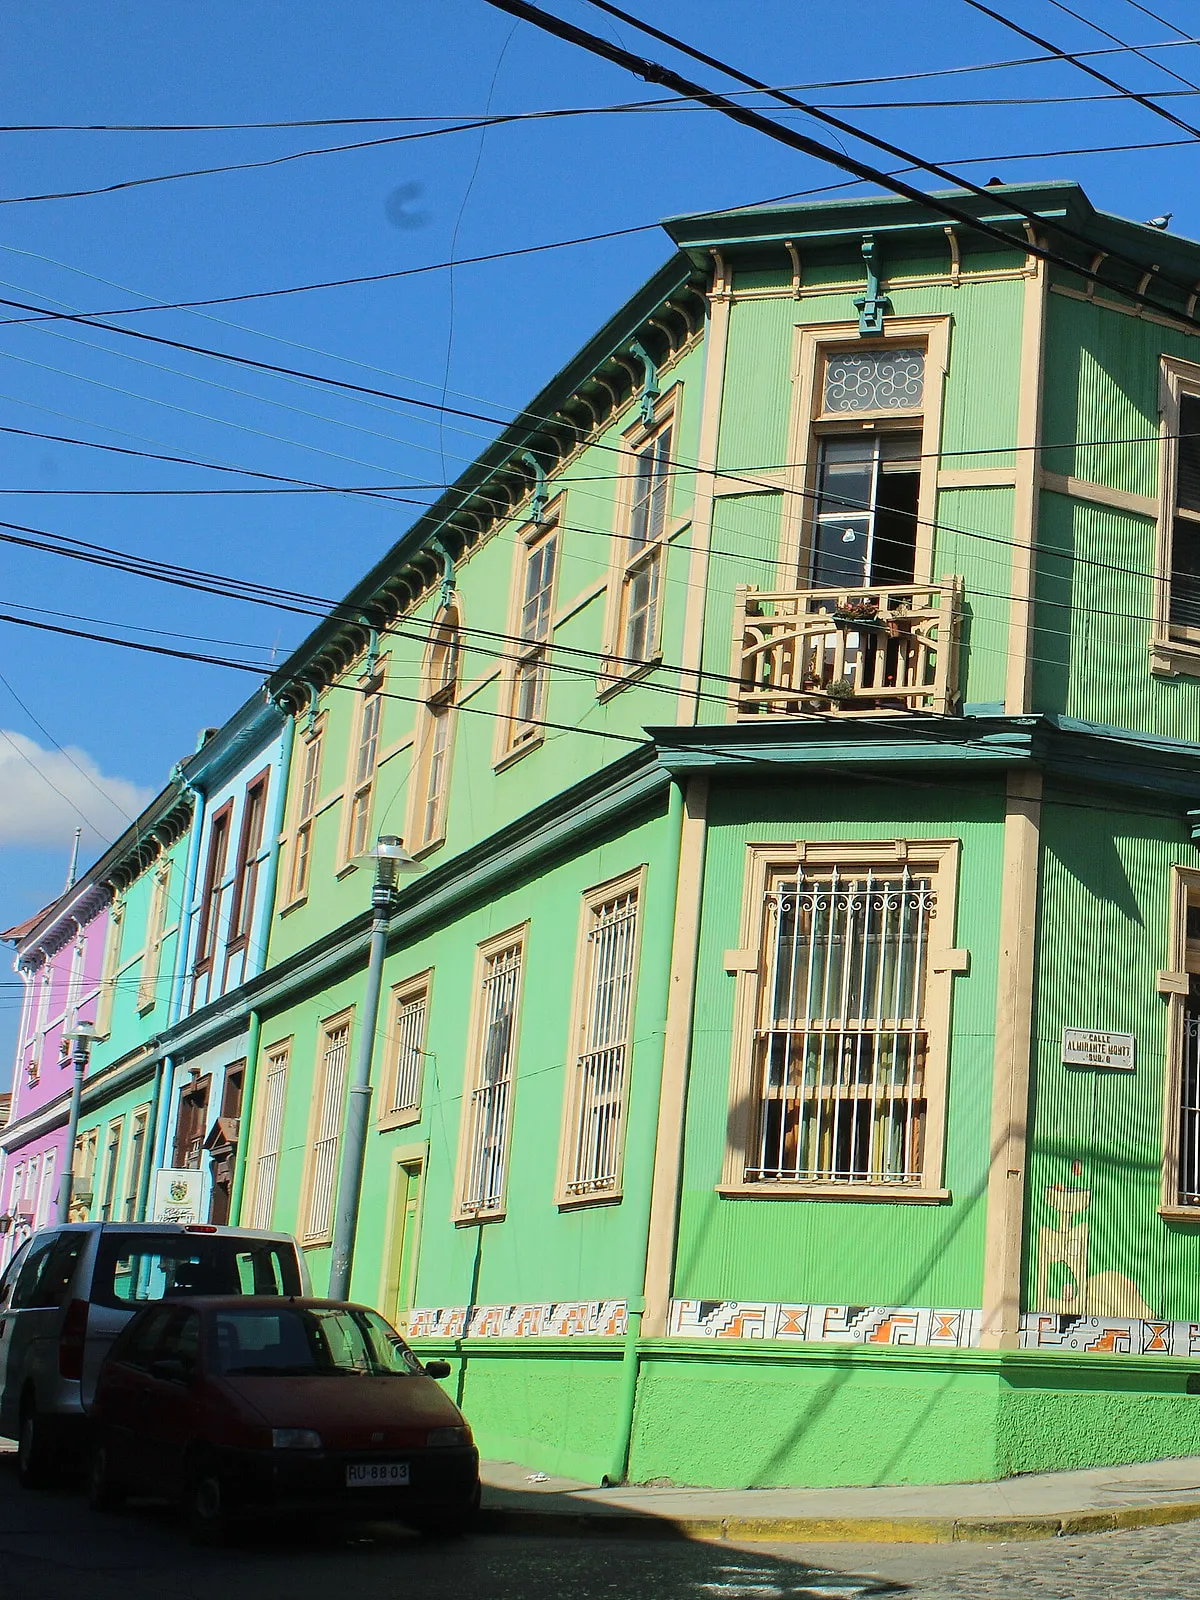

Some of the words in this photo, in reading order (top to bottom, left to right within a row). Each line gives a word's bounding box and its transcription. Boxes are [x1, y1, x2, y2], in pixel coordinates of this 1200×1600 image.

[1089, 1034, 1111, 1043] CALLE
[1067, 1040, 1106, 1054] ALMIRANTE
[1108, 1044, 1130, 1057] MONTT
